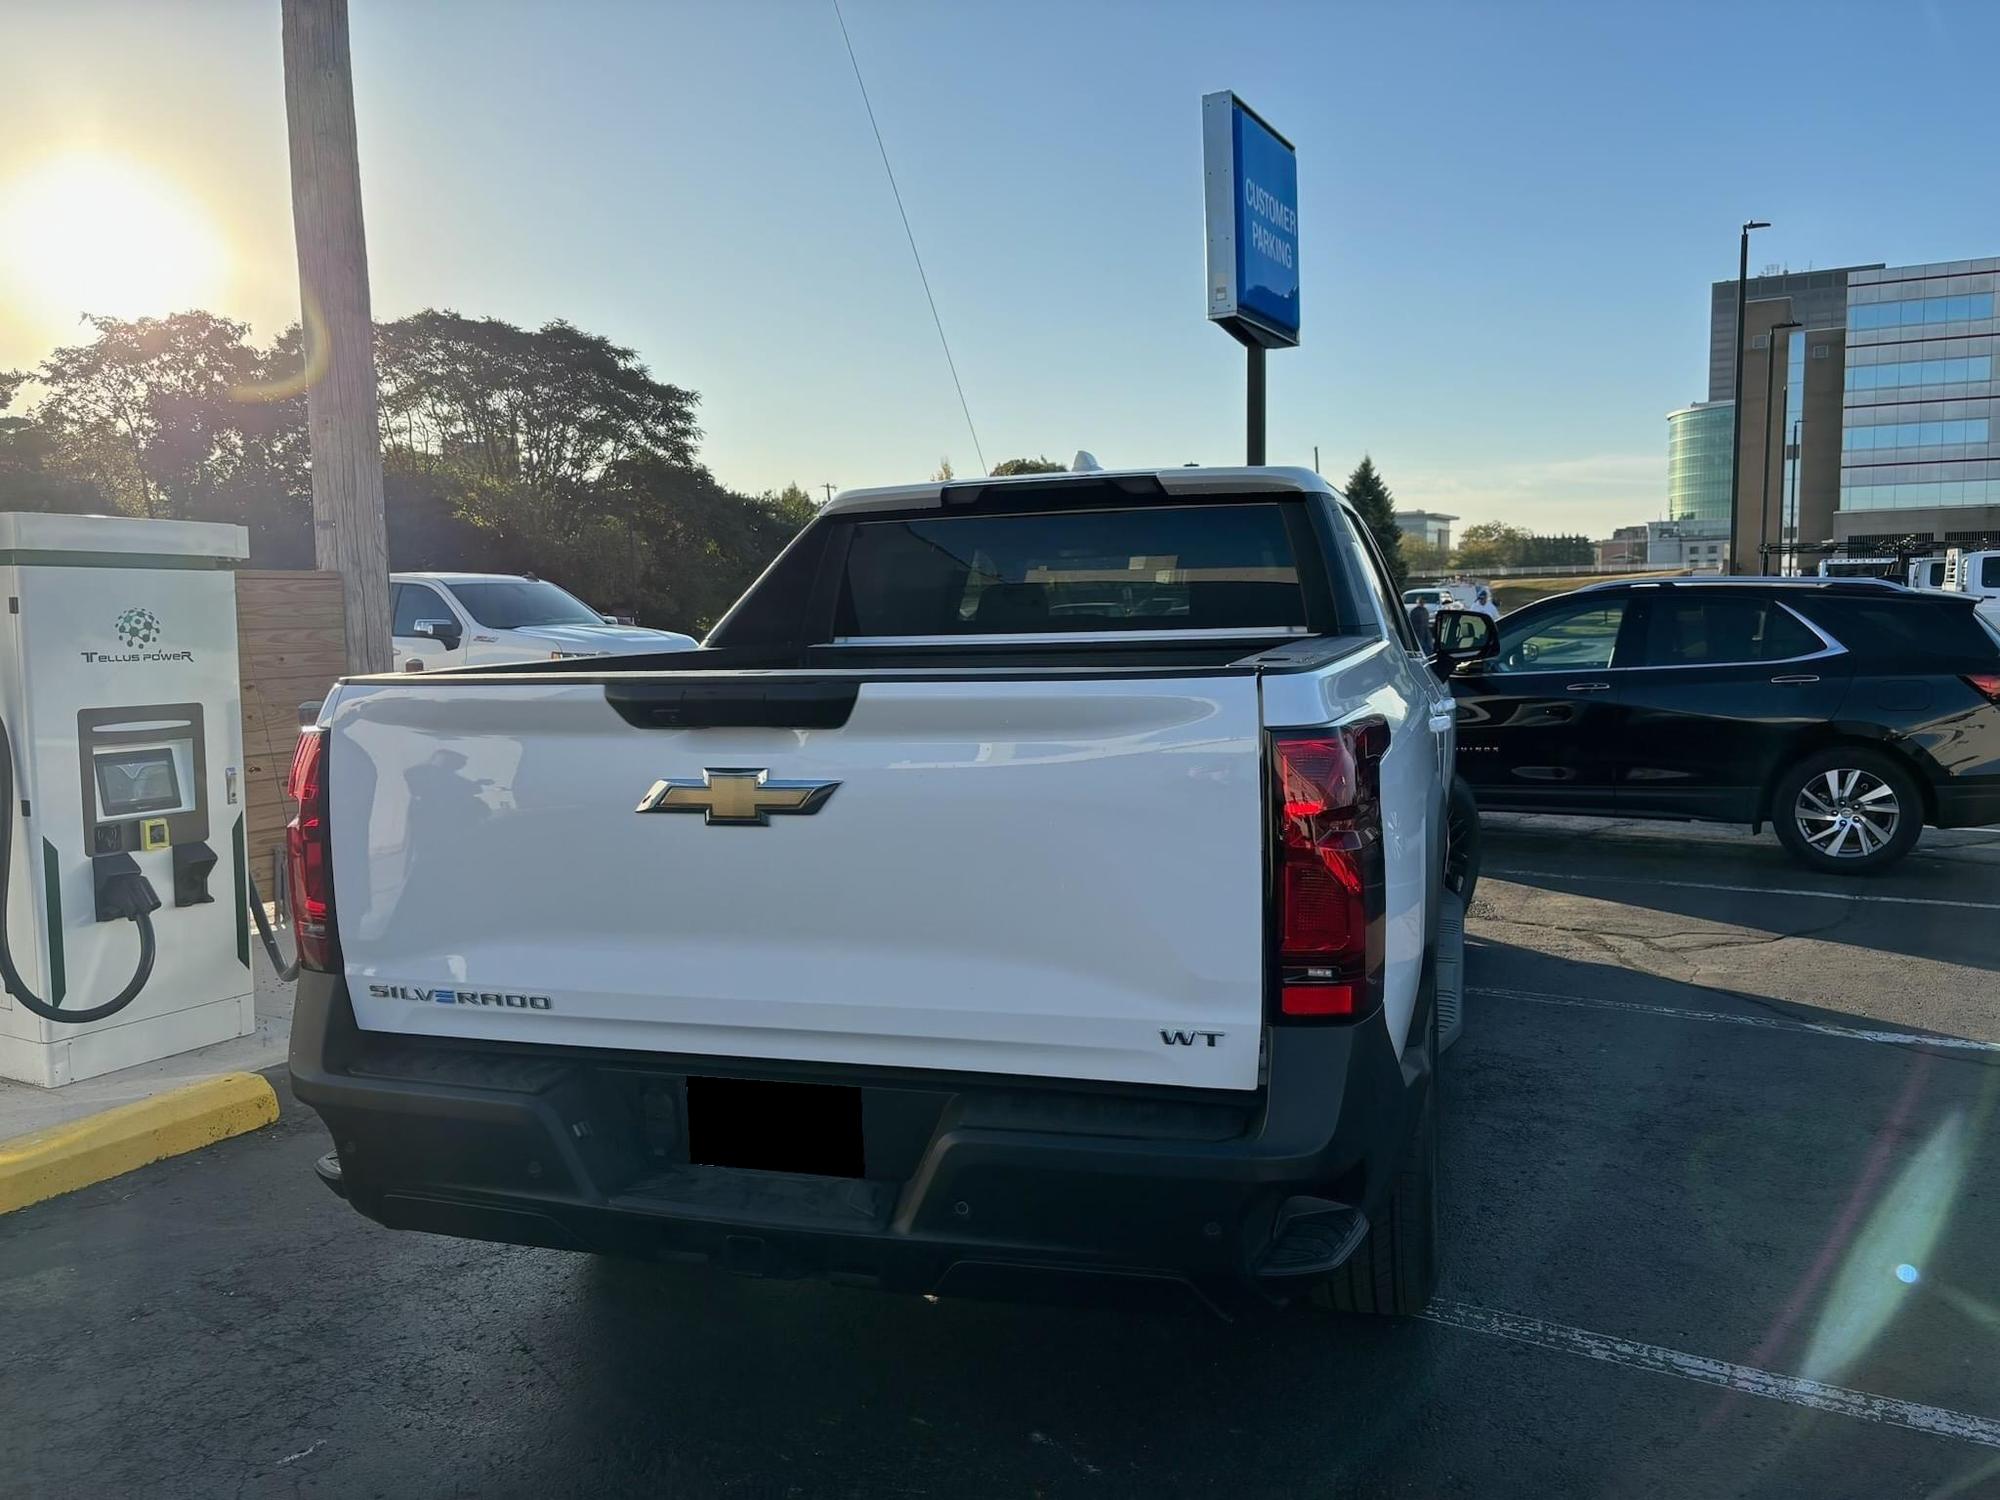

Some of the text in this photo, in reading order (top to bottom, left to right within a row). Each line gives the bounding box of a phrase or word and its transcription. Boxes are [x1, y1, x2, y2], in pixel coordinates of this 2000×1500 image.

[1245, 178, 1297, 237] CUSTOMER
[1252, 221, 1293, 269] PARKING
[368, 984, 553, 1010] SILVERADO
[1159, 1028, 1225, 1047] WT
